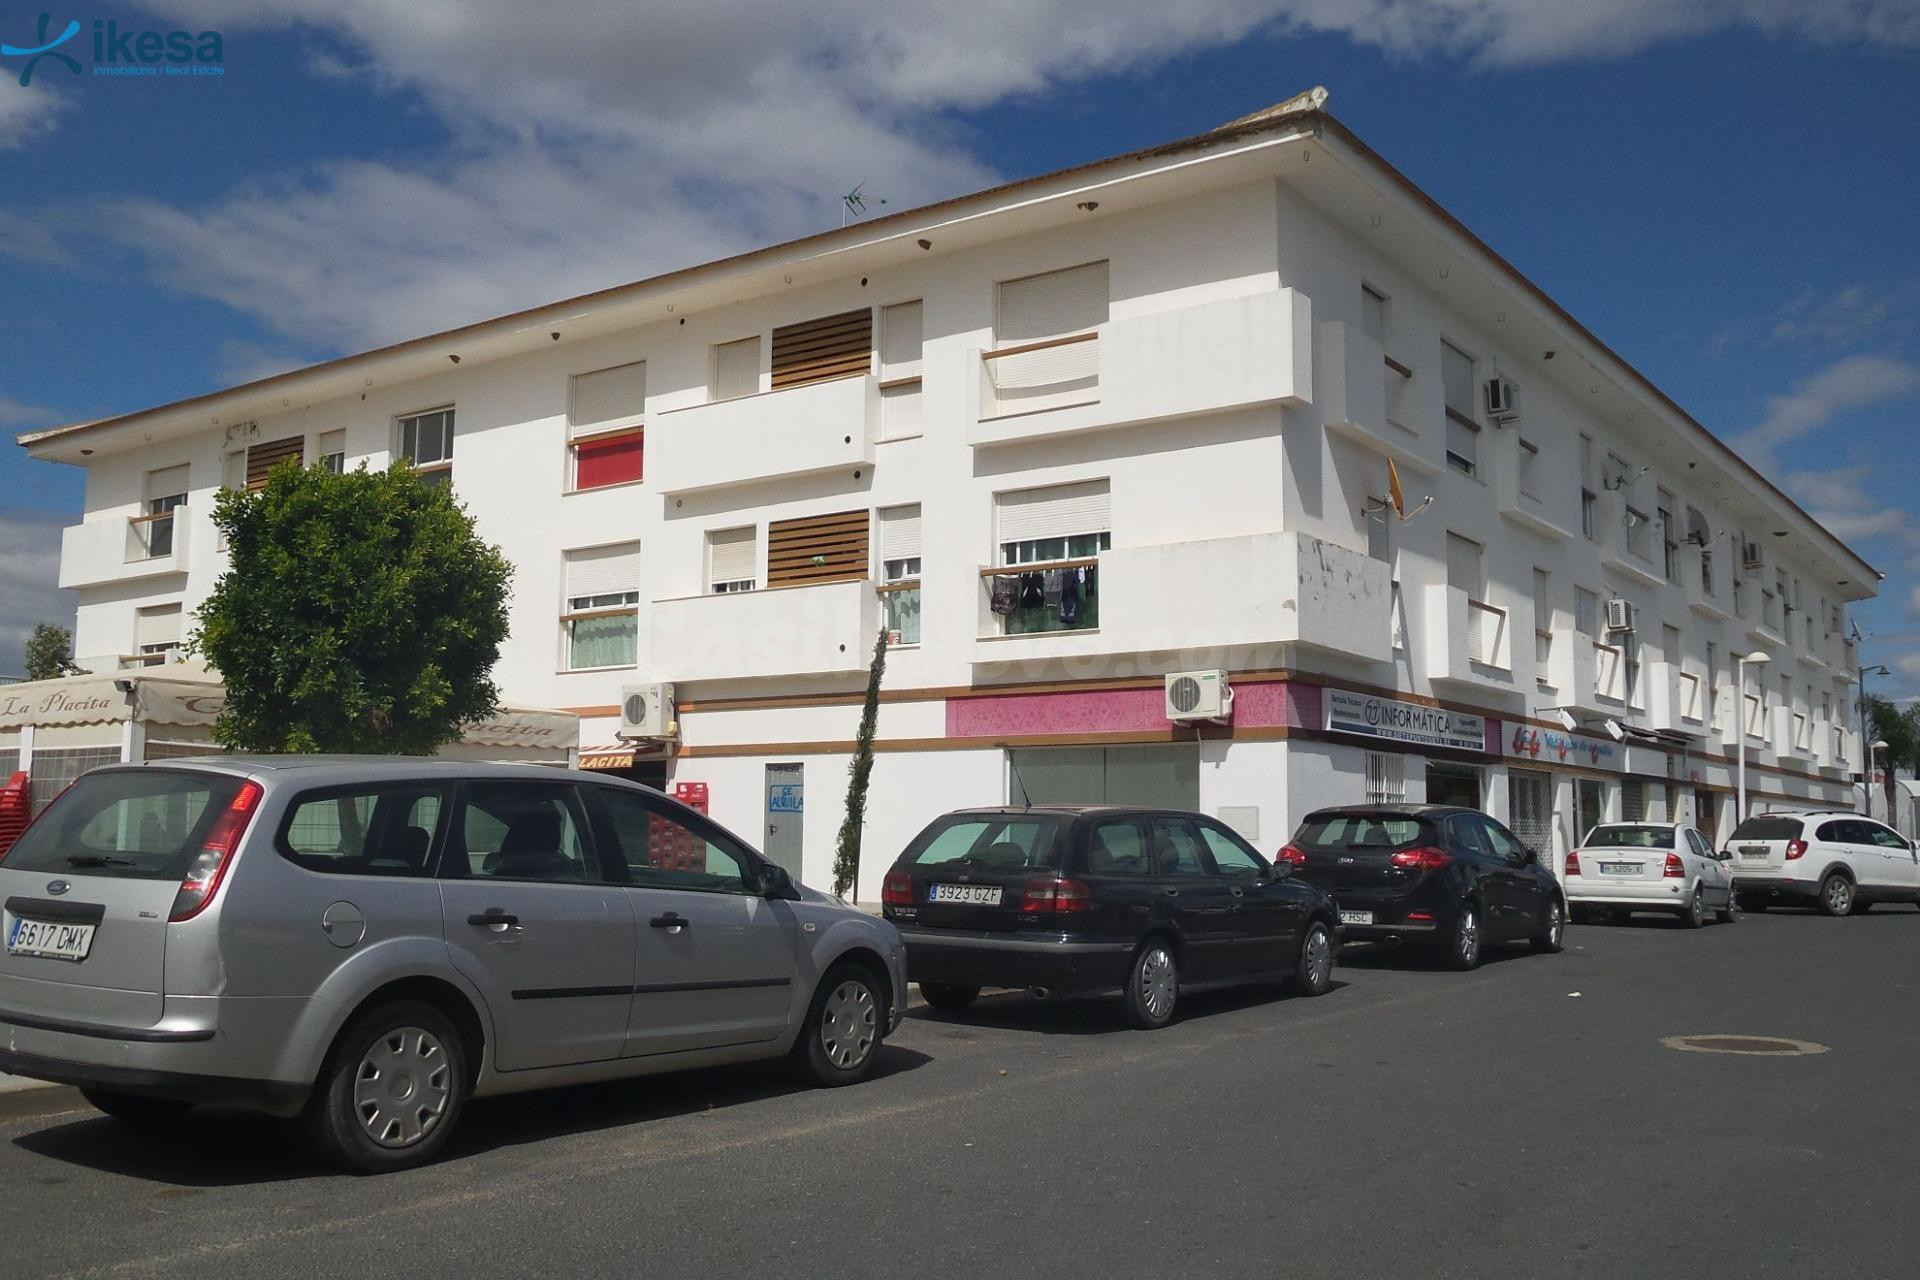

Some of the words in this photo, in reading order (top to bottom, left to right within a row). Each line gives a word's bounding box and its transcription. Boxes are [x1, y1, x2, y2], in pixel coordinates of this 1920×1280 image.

[1, 696, 31, 716] La
[40, 689, 111, 713] Placita
[465, 722, 555, 736] acita
[577, 755, 633, 768] LACITA
[939, 885, 970, 900] 3923
[974, 887, 998, 901] GZF
[1350, 911, 1367, 922] HSC
[18, 922, 57, 949] 6617
[56, 926, 88, 951] DMX
